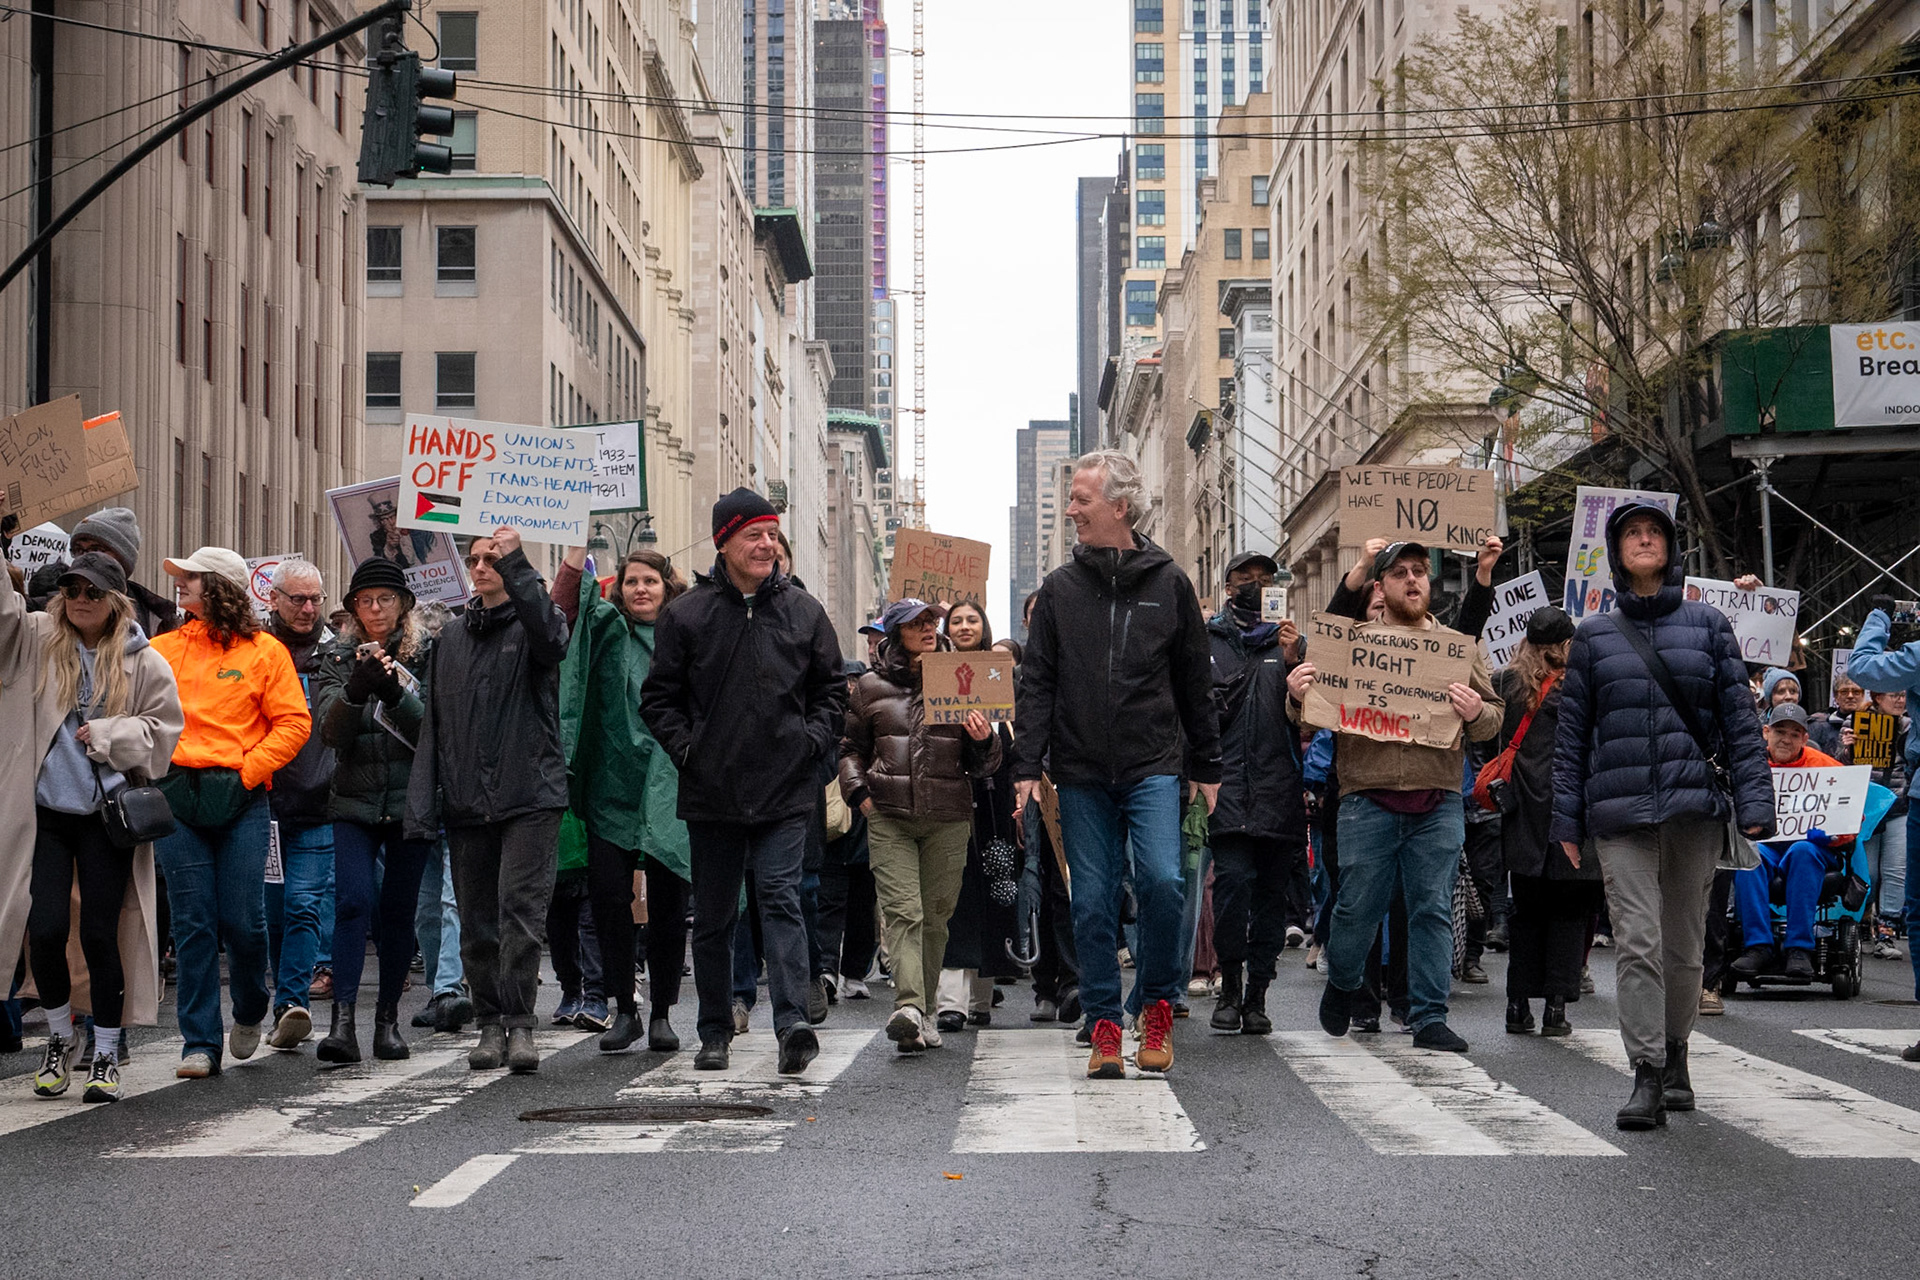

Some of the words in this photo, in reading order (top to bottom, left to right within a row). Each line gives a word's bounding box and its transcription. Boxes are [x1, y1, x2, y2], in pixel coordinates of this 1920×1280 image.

[1856, 328, 1915, 351] etc.
[1859, 356, 1920, 376] Brea
[409, 424, 496, 462] HANDS
[504, 432, 576, 450] UNIONS
[20, 442, 62, 476] FUCK
[36, 450, 71, 487] YOU!
[503, 451, 595, 471] STUDENTS
[412, 461, 477, 492] OFF
[603, 463, 635, 477] THEM
[486, 471, 592, 494] TRANS-HEALTH
[591, 483, 625, 498] 789!
[1346, 470, 1372, 486] WE
[1378, 471, 1412, 486] THE
[1417, 471, 1479, 493] PEOPLE
[483, 489, 569, 510] EDUCATION
[1348, 493, 1383, 508] HAVE
[479, 511, 584, 535] ENVIRONMENT
[1447, 523, 1493, 546] KINGS
[29, 550, 51, 564] NOT
[906, 542, 982, 580] REGIME
[420, 565, 447, 579] YOU
[423, 575, 457, 588] SCIENCE
[415, 587, 443, 598] OCRACY
[1505, 581, 1537, 608] ONE
[1566, 578, 1617, 618] NOR
[1348, 628, 1418, 651] DANGEROUS
[1423, 639, 1440, 653] TO
[1447, 642, 1467, 658] BE
[1486, 625, 1506, 643] IS
[1352, 647, 1416, 677] RIGHT
[1354, 679, 1377, 691] THE
[928, 696, 961, 706] VIVA
[966, 695, 982, 705] LA
[1368, 694, 1388, 708] IS
[1854, 711, 1895, 742] END
[1854, 740, 1893, 758] WHITE
